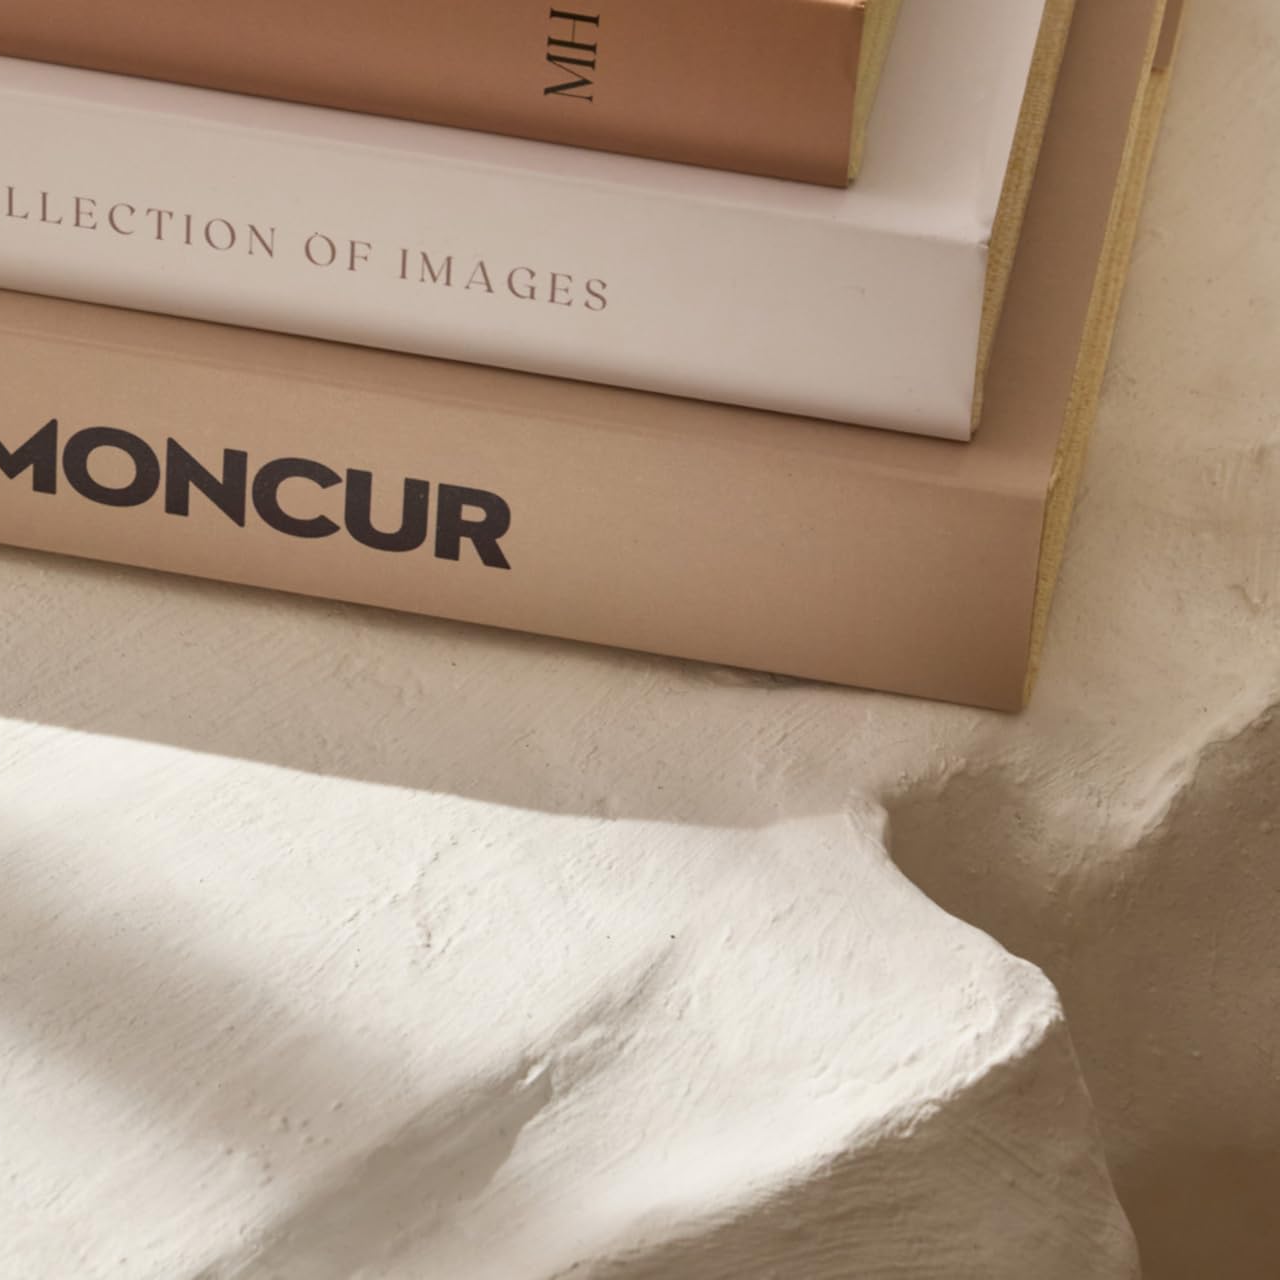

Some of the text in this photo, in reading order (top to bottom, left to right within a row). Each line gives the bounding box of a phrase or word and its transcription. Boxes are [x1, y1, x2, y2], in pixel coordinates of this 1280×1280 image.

[544, 8, 600, 103] MH
[304, 232, 373, 272] OF
[398, 248, 609, 311] IMAGES
